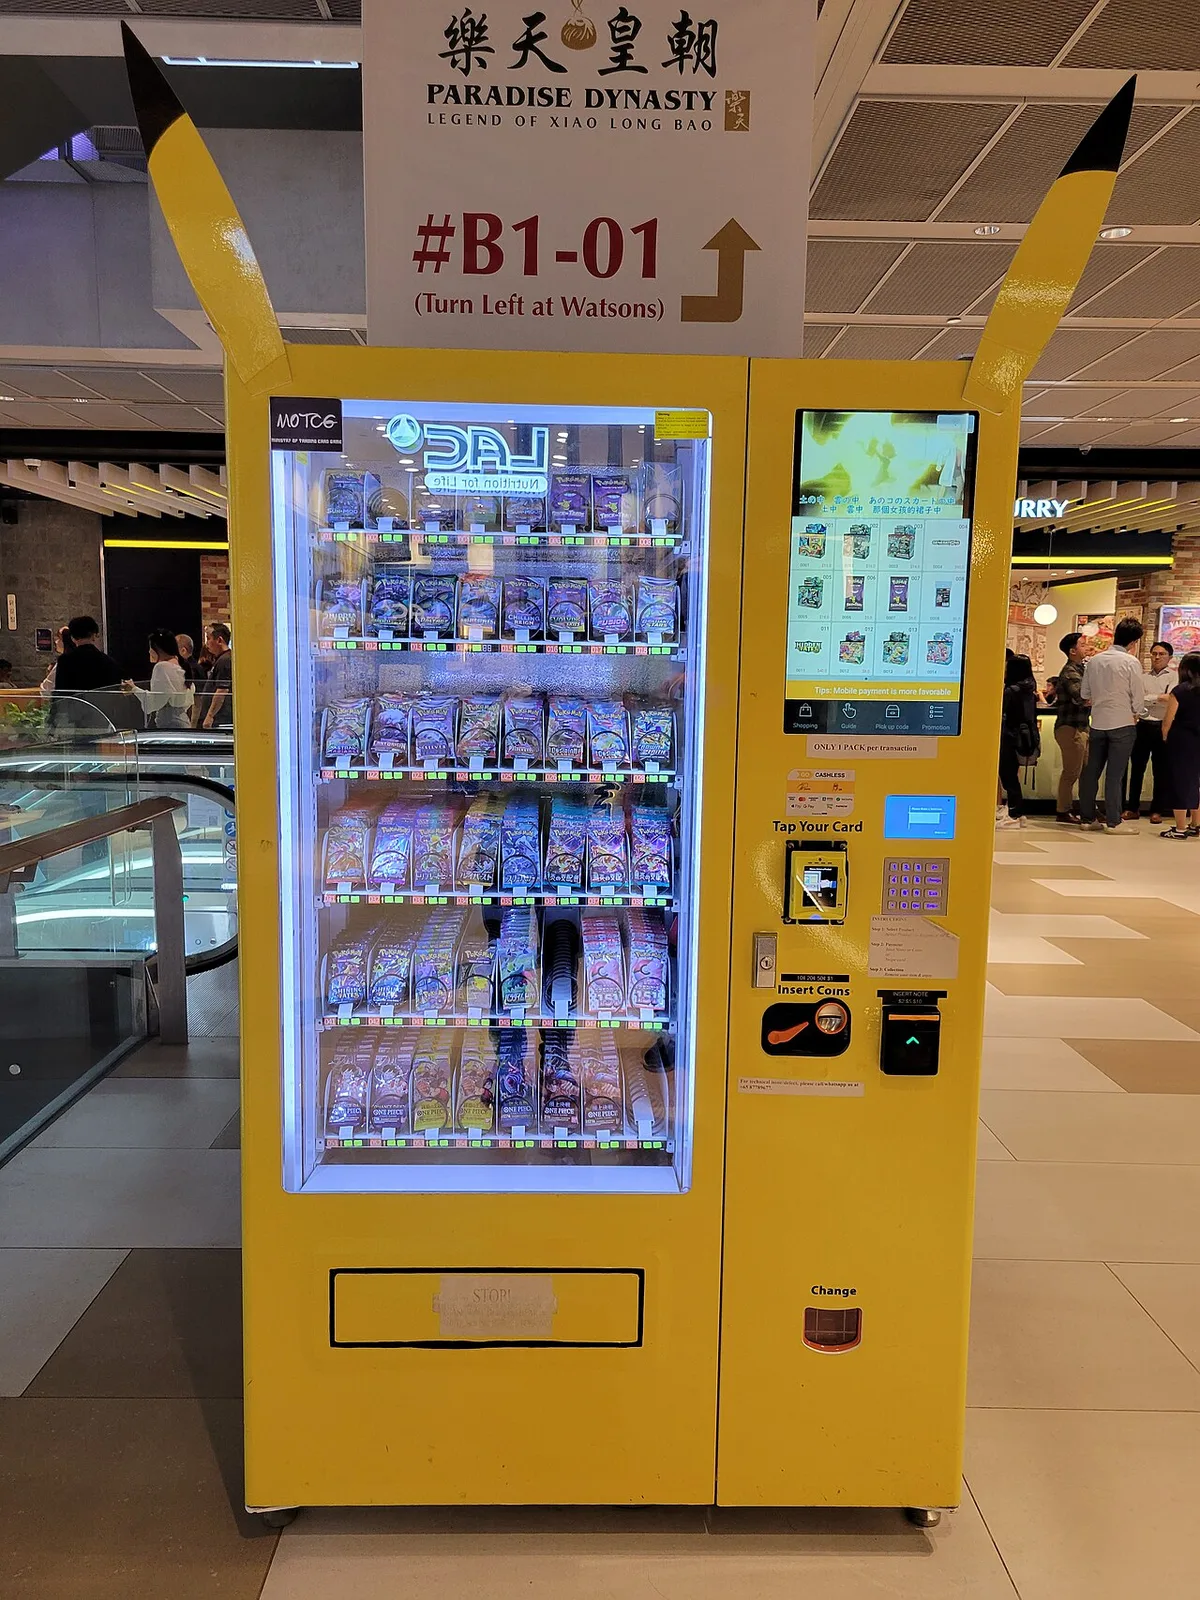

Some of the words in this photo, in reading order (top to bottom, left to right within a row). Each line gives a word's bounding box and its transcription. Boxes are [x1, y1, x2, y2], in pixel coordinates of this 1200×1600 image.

[437, 7, 719, 79] 樂天皇朝
[427, 84, 572, 108] PARADISE
[585, 89, 717, 111] DYNASTY
[428, 113, 502, 127] LEGEND
[515, 115, 537, 128] OF
[549, 116, 597, 129] XIAO
[610, 118, 662, 130] LONG
[674, 118, 713, 132] BAO
[412, 212, 658, 279] #B1-01
[414, 292, 473, 316] (Turn
[482, 294, 525, 316] Left
[531, 297, 554, 317] at
[561, 296, 664, 322] Watsons)
[277, 412, 338, 429] MOTCG
[814, 686, 832, 695] Tips:
[833, 687, 857, 695] Mobile
[858, 688, 890, 696] payment
[918, 688, 951, 696] favorable
[793, 722, 818, 730] Shopping
[772, 821, 797, 834] Tap
[799, 821, 830, 832] Your
[832, 821, 863, 832] Card
[778, 985, 814, 995] Insert
[817, 986, 850, 996] Coins
[473, 1289, 511, 1302] STOP!
[811, 1285, 857, 1298] Change
